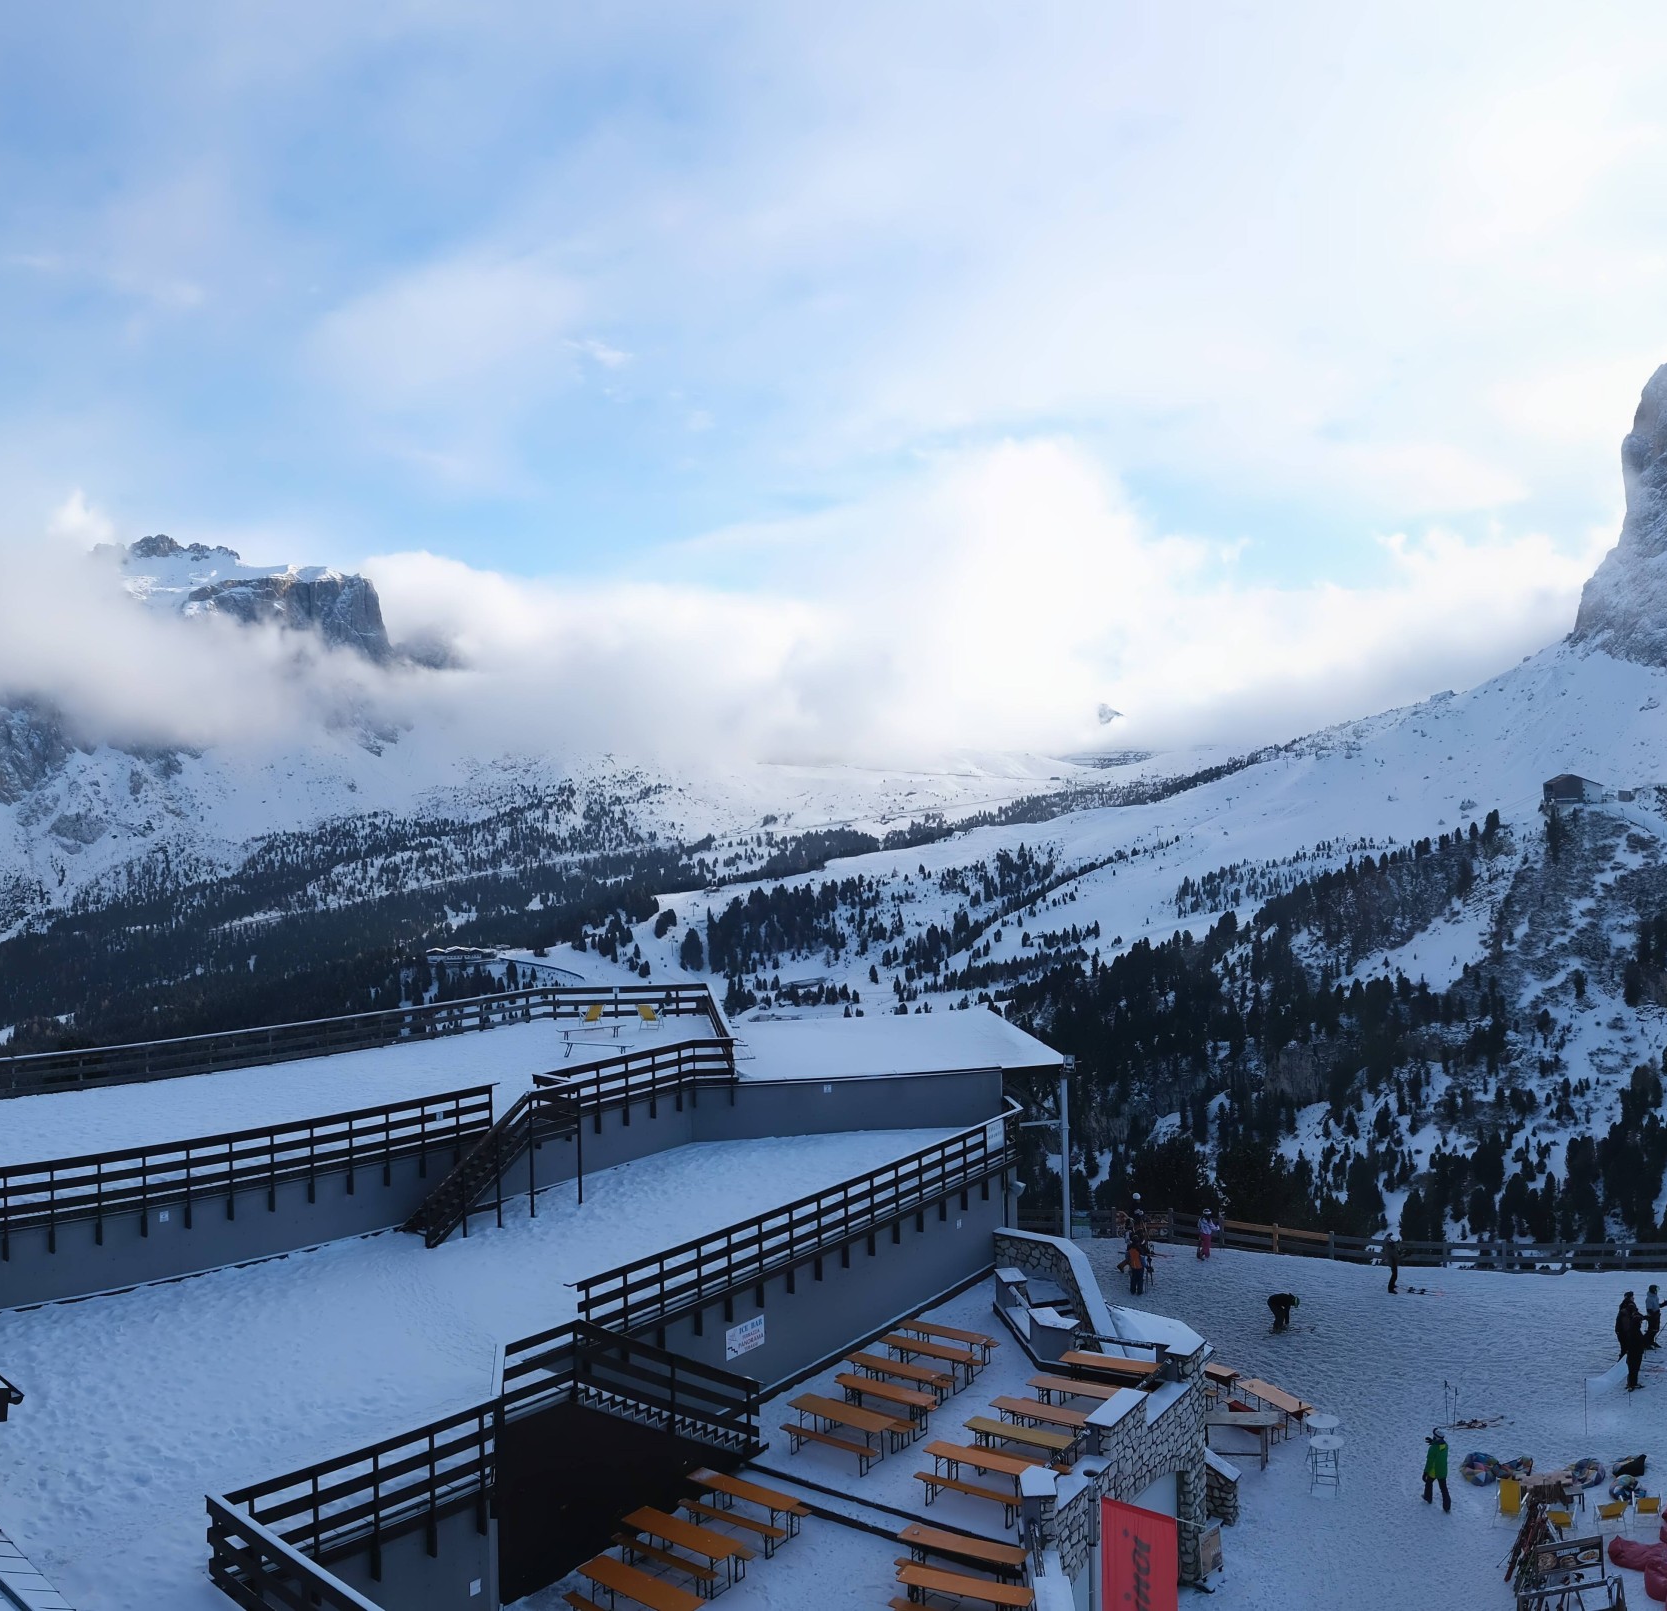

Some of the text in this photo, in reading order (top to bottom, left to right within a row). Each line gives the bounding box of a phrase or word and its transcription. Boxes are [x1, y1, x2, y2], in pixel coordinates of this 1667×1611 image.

[739, 1318, 762, 1334] ICE BAR
[738, 1333, 764, 1349] PANORAMA
